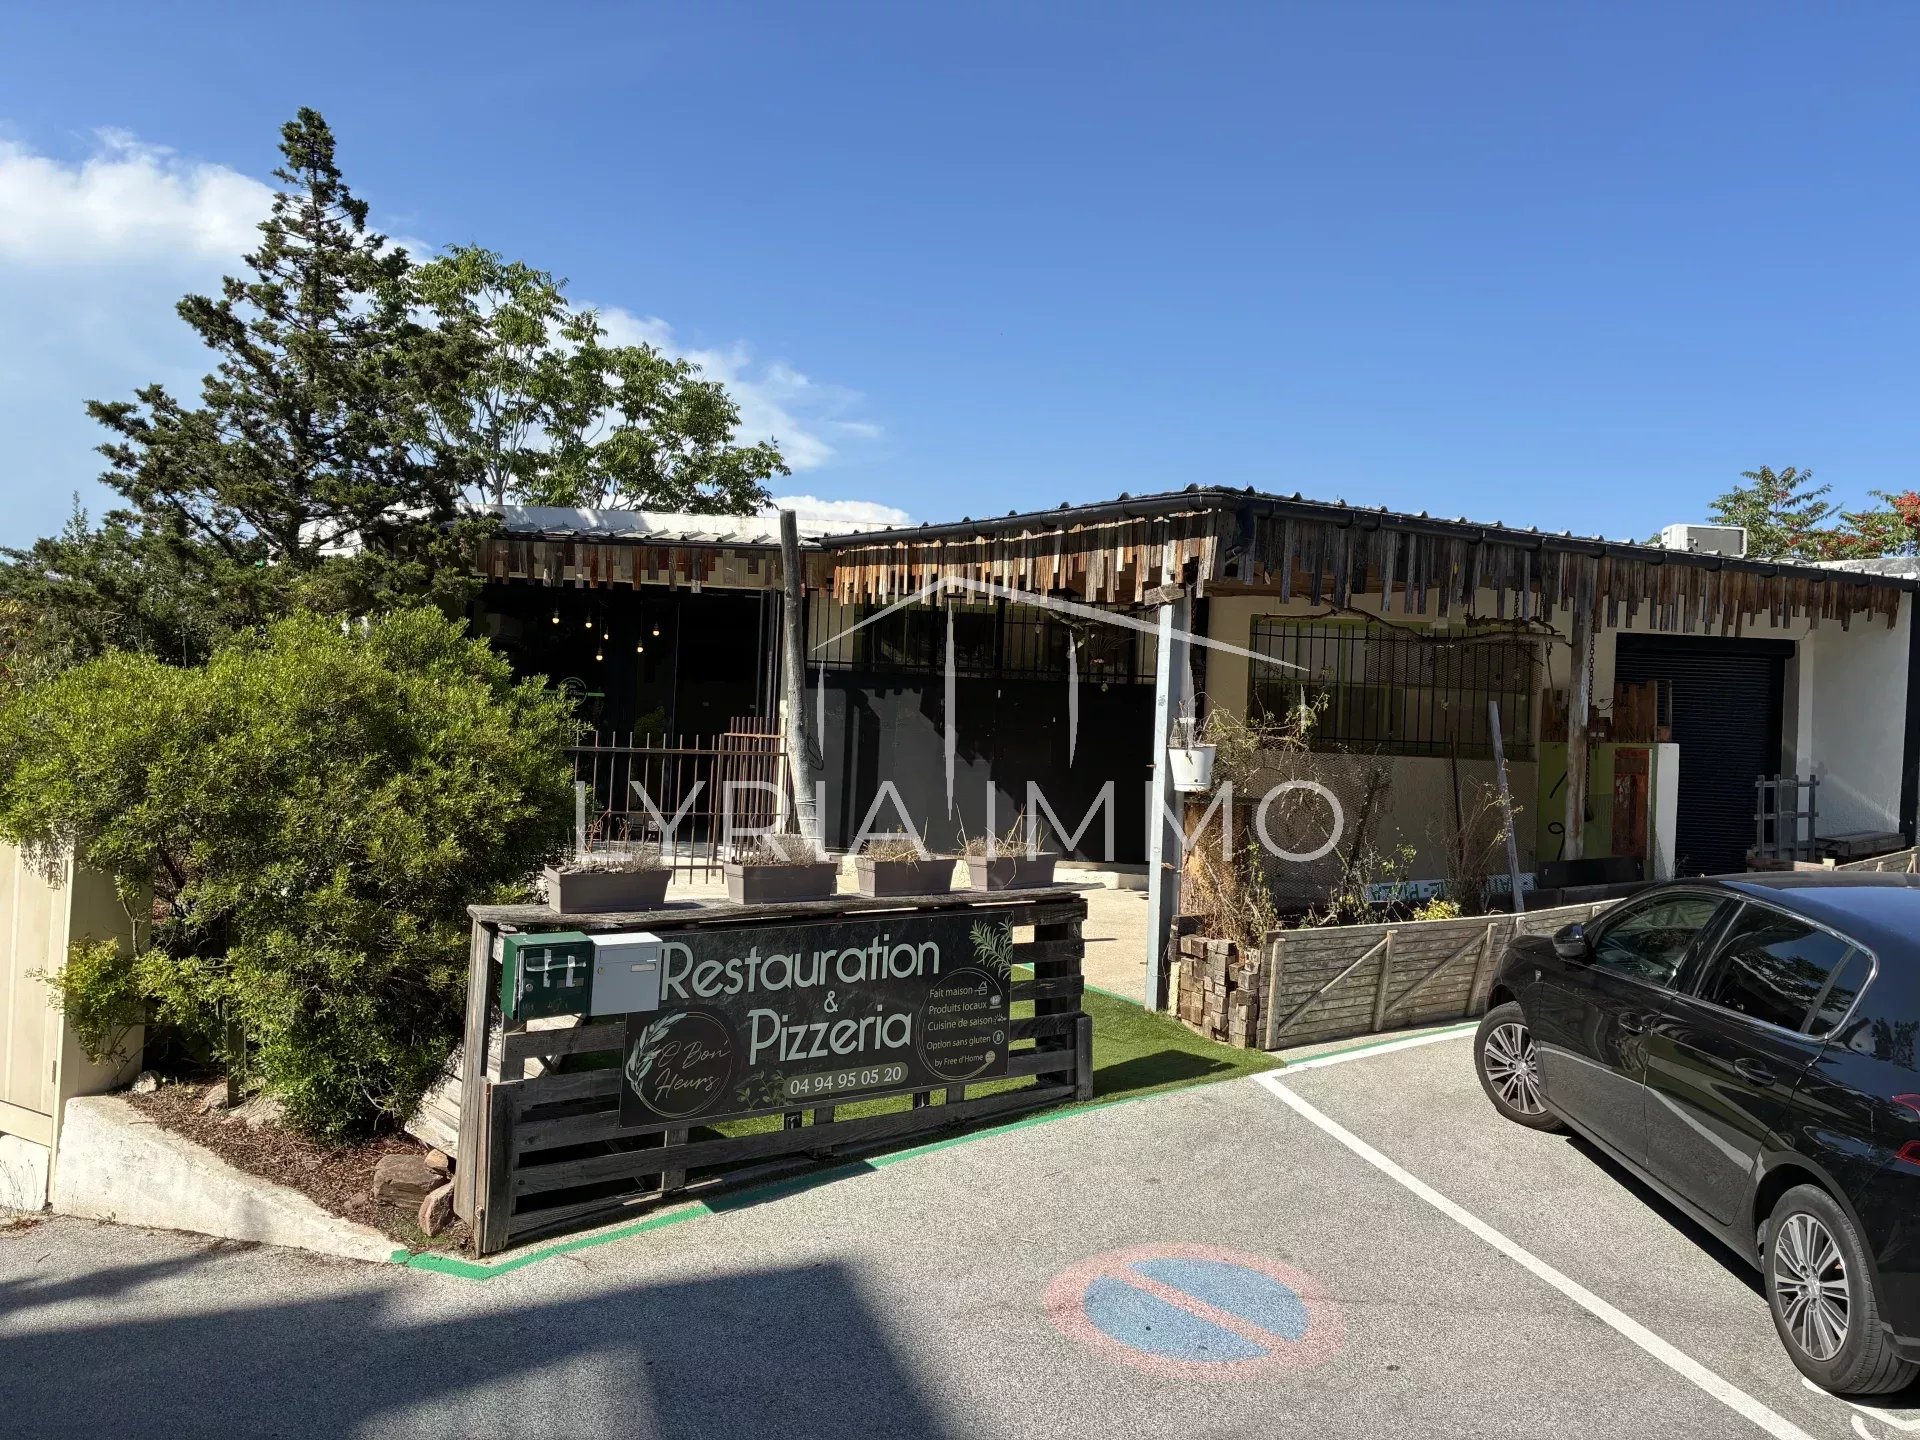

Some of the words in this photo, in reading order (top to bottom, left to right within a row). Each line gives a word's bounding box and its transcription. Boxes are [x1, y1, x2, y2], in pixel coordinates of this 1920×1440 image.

[661, 934, 940, 1000] Restauration
[823, 990, 839, 1013] &
[929, 988, 944, 999] Fait
[945, 986, 973, 997] maison
[928, 1004, 961, 1015] Produits
[962, 1001, 988, 1012] locaux
[927, 1020, 957, 1031] Cuisine
[957, 1017, 968, 1028] de
[969, 1016, 993, 1027] saison
[746, 1004, 913, 1066] Pizzeria
[926, 1039, 952, 1051] Option
[952, 1037, 968, 1046] sans
[969, 1035, 991, 1047] gluten
[934, 1058, 943, 1068] by
[943, 1056, 958, 1066] Free
[958, 1053, 984, 1064] d'Home
[654, 1067, 720, 1102] Heurs
[790, 1078, 810, 1095] 04
[814, 1075, 834, 1092] 94
[838, 1072, 857, 1091] 95
[861, 1070, 880, 1086] 05
[884, 1066, 902, 1083] 20
